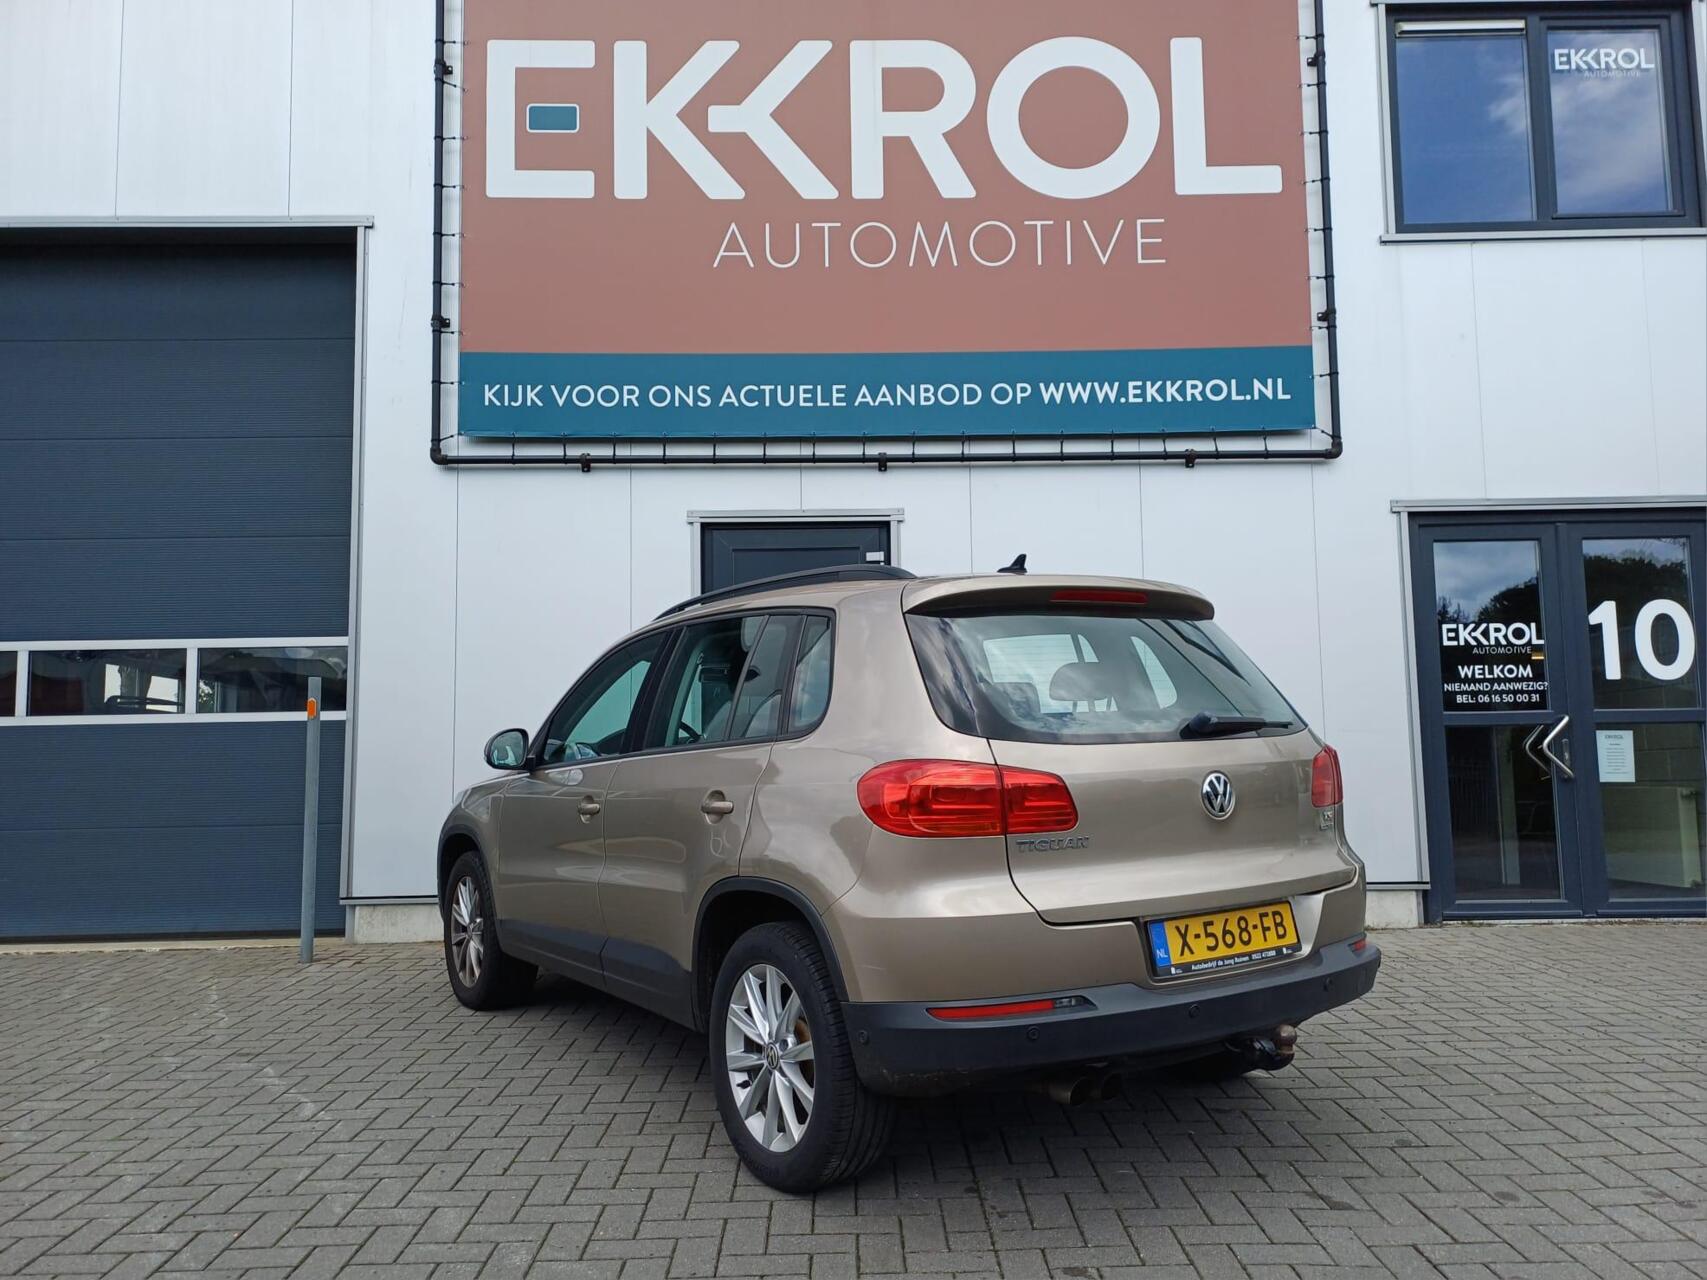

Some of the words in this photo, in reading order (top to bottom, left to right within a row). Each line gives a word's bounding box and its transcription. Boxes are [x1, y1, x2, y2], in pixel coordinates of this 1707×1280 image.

[1554, 48, 1655, 70] EKKROL
[485, 36, 1283, 200] EKKROL
[713, 218, 1167, 268] AUTOMOTIVE
[483, 384, 544, 407] KIJK
[550, 384, 640, 407] VOOR
[649, 384, 712, 407] ONS
[718, 384, 847, 407] ACTUELE
[854, 383, 982, 406] AANBOD
[990, 382, 1032, 405] OP
[1039, 378, 1291, 404] WWW.EKKROL.NL
[1442, 622, 1544, 646] EKKROL
[1588, 599, 1696, 680] 10
[1472, 646, 1532, 654] AUTOMOTIVE
[1458, 664, 1533, 679] WELKOM
[1444, 682, 1491, 692] NIEMAND
[1492, 681, 1548, 691] AANWEZIG?
[1456, 694, 1476, 703] BEL:
[1477, 694, 1490, 703] 06
[1491, 694, 1501, 703] 16
[1502, 693, 1515, 702] 50
[1516, 693, 1529, 702] 00
[1530, 693, 1540, 702] 31
[1016, 835, 1089, 853] TIGUAN
[1156, 949, 1168, 958] NL
[1174, 910, 1287, 957] X-568-FB
